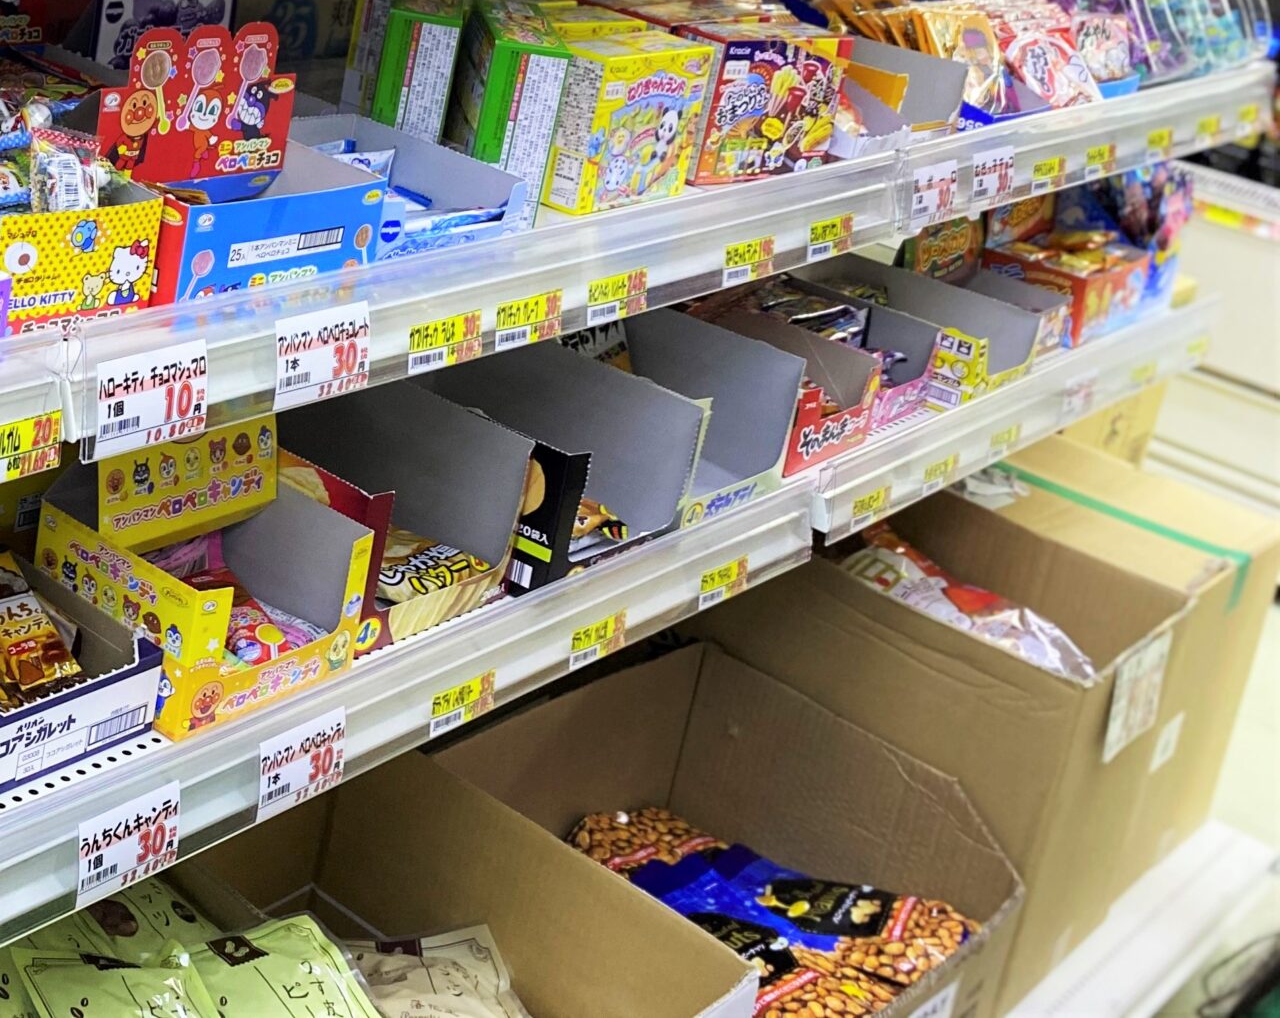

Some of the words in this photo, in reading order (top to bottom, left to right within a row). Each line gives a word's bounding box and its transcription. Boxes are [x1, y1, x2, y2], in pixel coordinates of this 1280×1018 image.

[233, 136, 272, 153] アンパンマン
[215, 150, 281, 171] ペロペロチョコ
[5, 229, 39, 241] マシュマロ
[267, 265, 318, 282] アンパンマン
[39, 290, 76, 307] KITTY
[277, 331, 314, 357] アンパンマン
[316, 317, 370, 347] ペロペロチョコレート
[284, 357, 300, 374] 1本
[331, 340, 359, 379] 30
[98, 370, 145, 401] ハローキティ
[149, 355, 207, 387] チョコマシュマロ
[106, 400, 125, 418] 1個
[163, 381, 193, 424] 10
[31, 414, 54, 448] 20
[145, 420, 186, 445] 10.80
[6, 453, 21, 472] 6粒
[112, 505, 158, 532] アンパンマン
[156, 473, 265, 520] ペロペロキャンディ
[97, 542, 133, 572] アンパンマン
[68, 540, 159, 607] ペロペロキャンディ
[407, 560, 472, 596] バター
[0, 617, 52, 639] キャンディ
[7, 640, 37, 656] コーラ味
[258, 656, 297, 681] アンパンマン
[219, 660, 321, 713] ペロペロキャンディ
[15, 715, 45, 735] オリオン
[44, 737, 85, 760] ココアシガレット
[260, 746, 297, 774] アンパンマン
[298, 721, 345, 755] ペロペロキャンディ
[308, 744, 334, 783] 30
[266, 772, 282, 790] 1本
[79, 798, 179, 858] うんちくんキャンディ
[135, 822, 167, 865] 30
[86, 853, 104, 872] 1個
